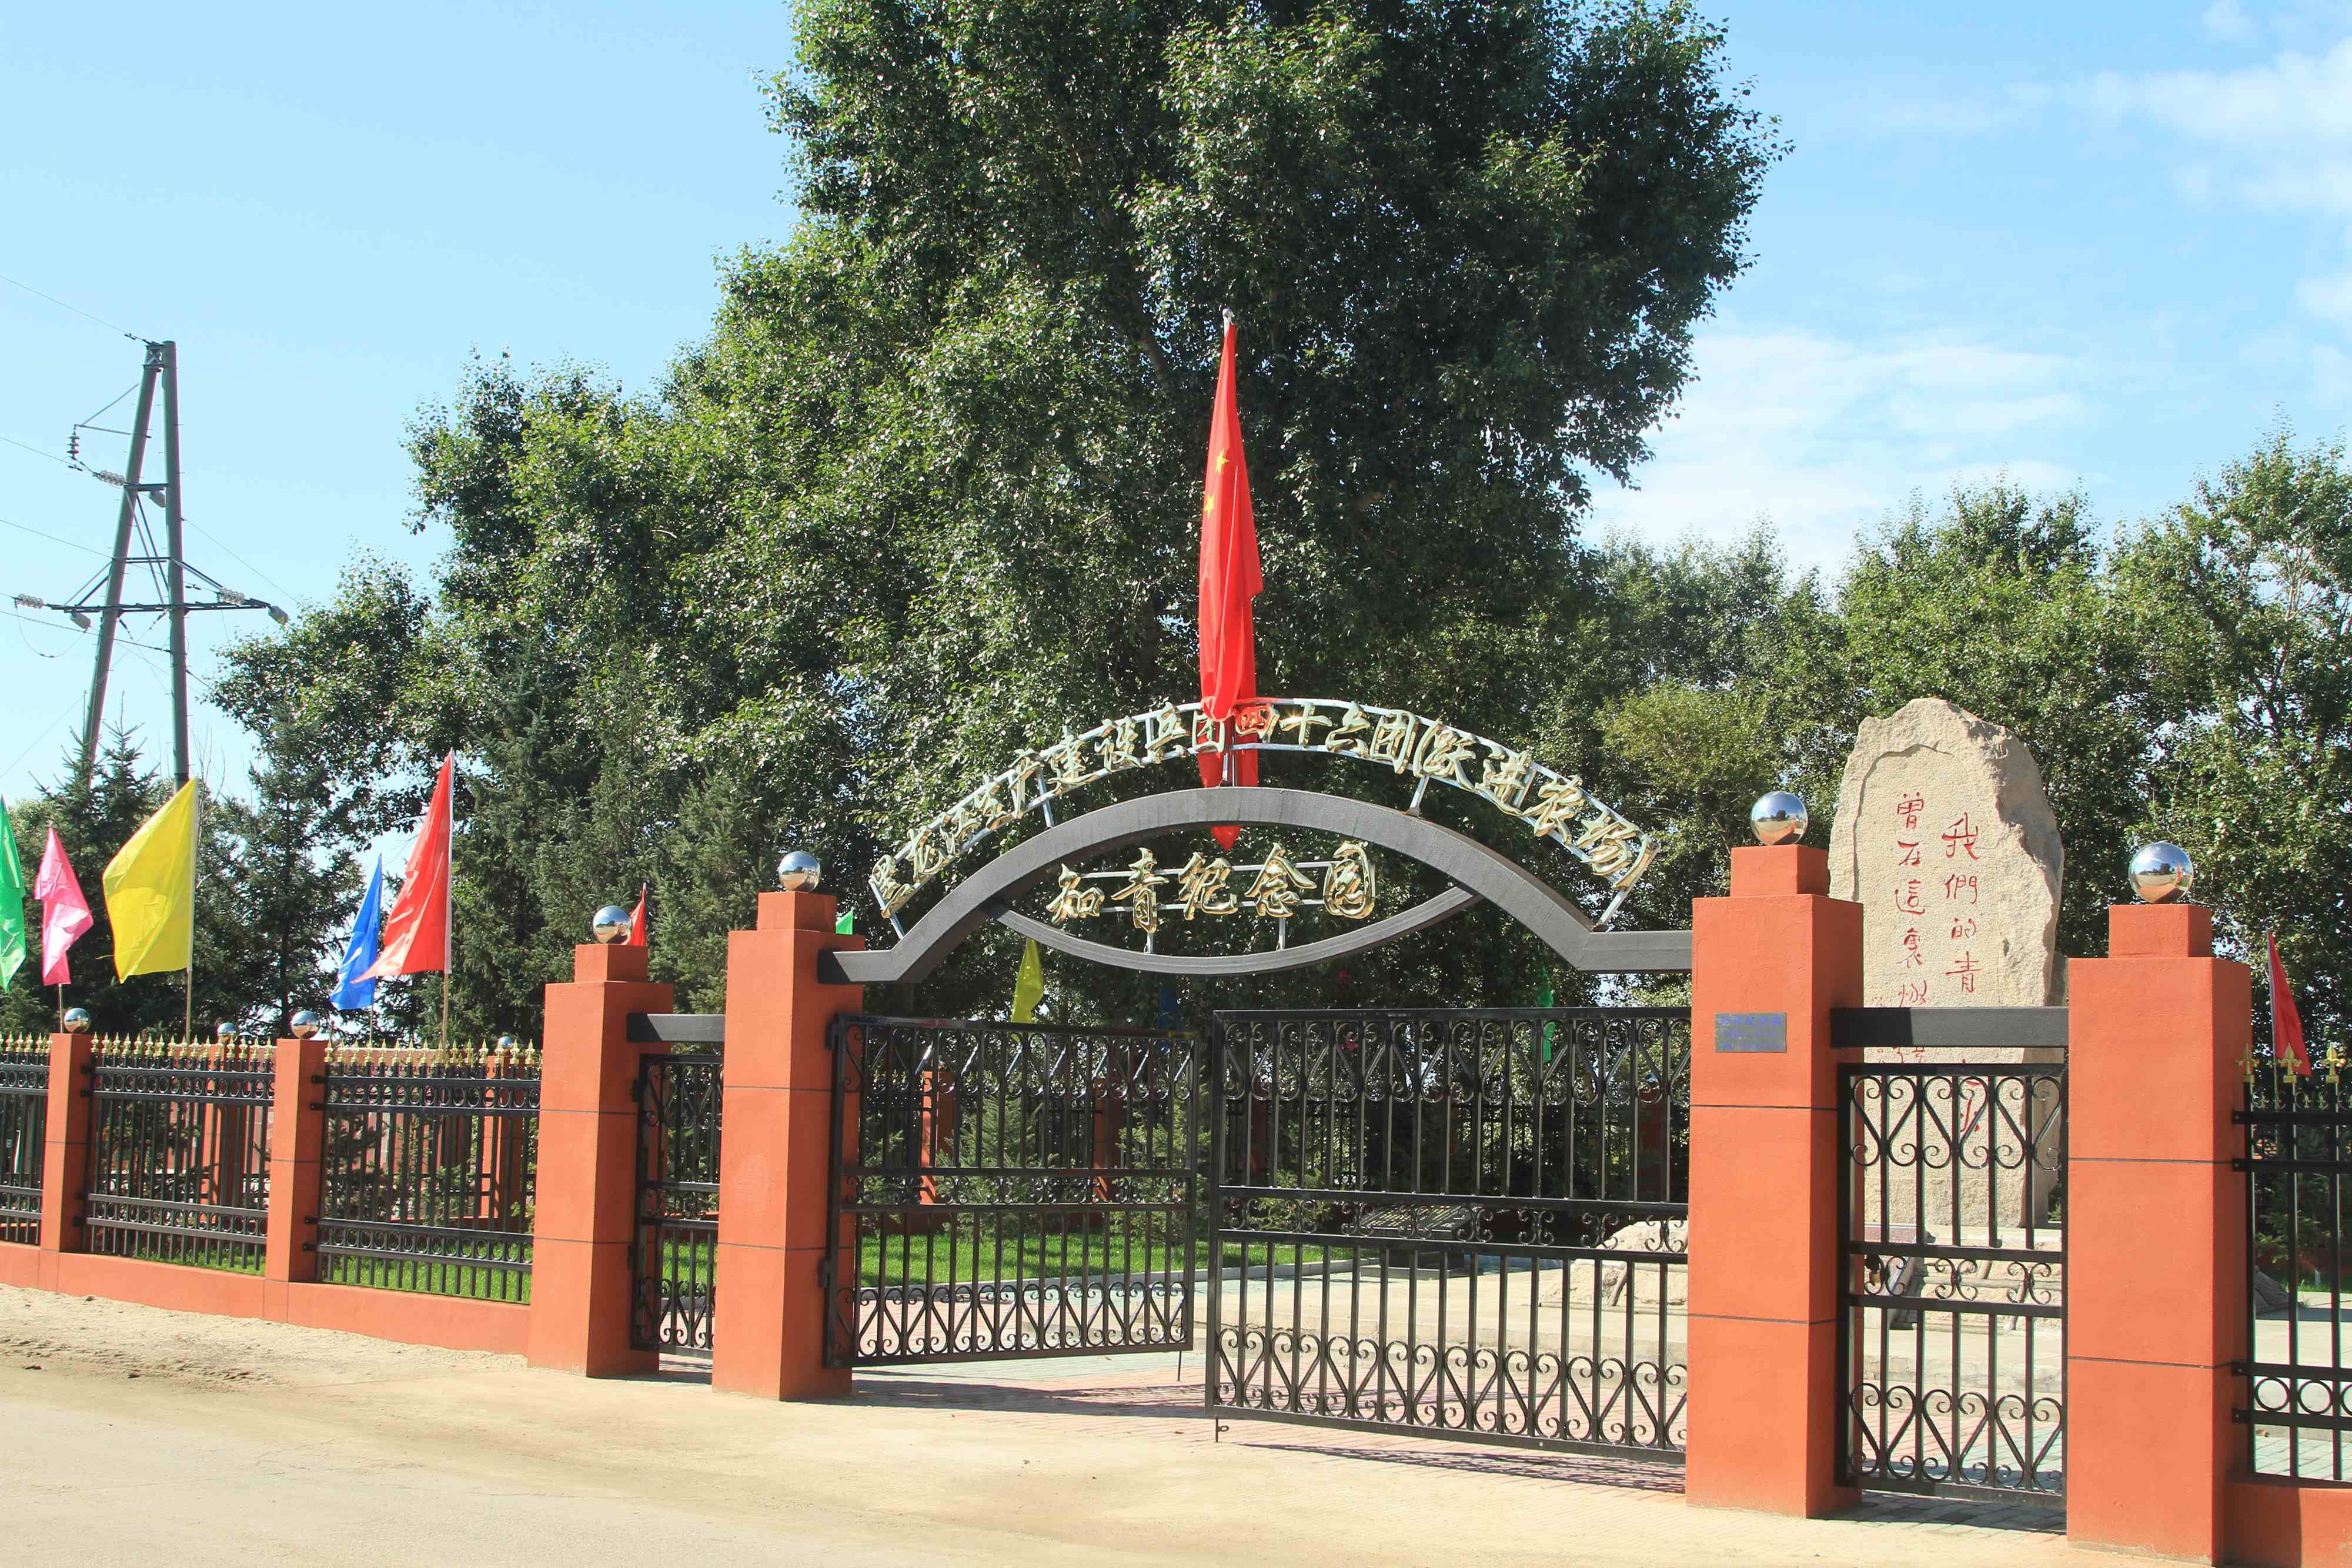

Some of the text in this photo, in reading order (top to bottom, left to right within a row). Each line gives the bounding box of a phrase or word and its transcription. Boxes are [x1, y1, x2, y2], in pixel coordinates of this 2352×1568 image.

[1045, 842, 1375, 934] 知青纪念园
